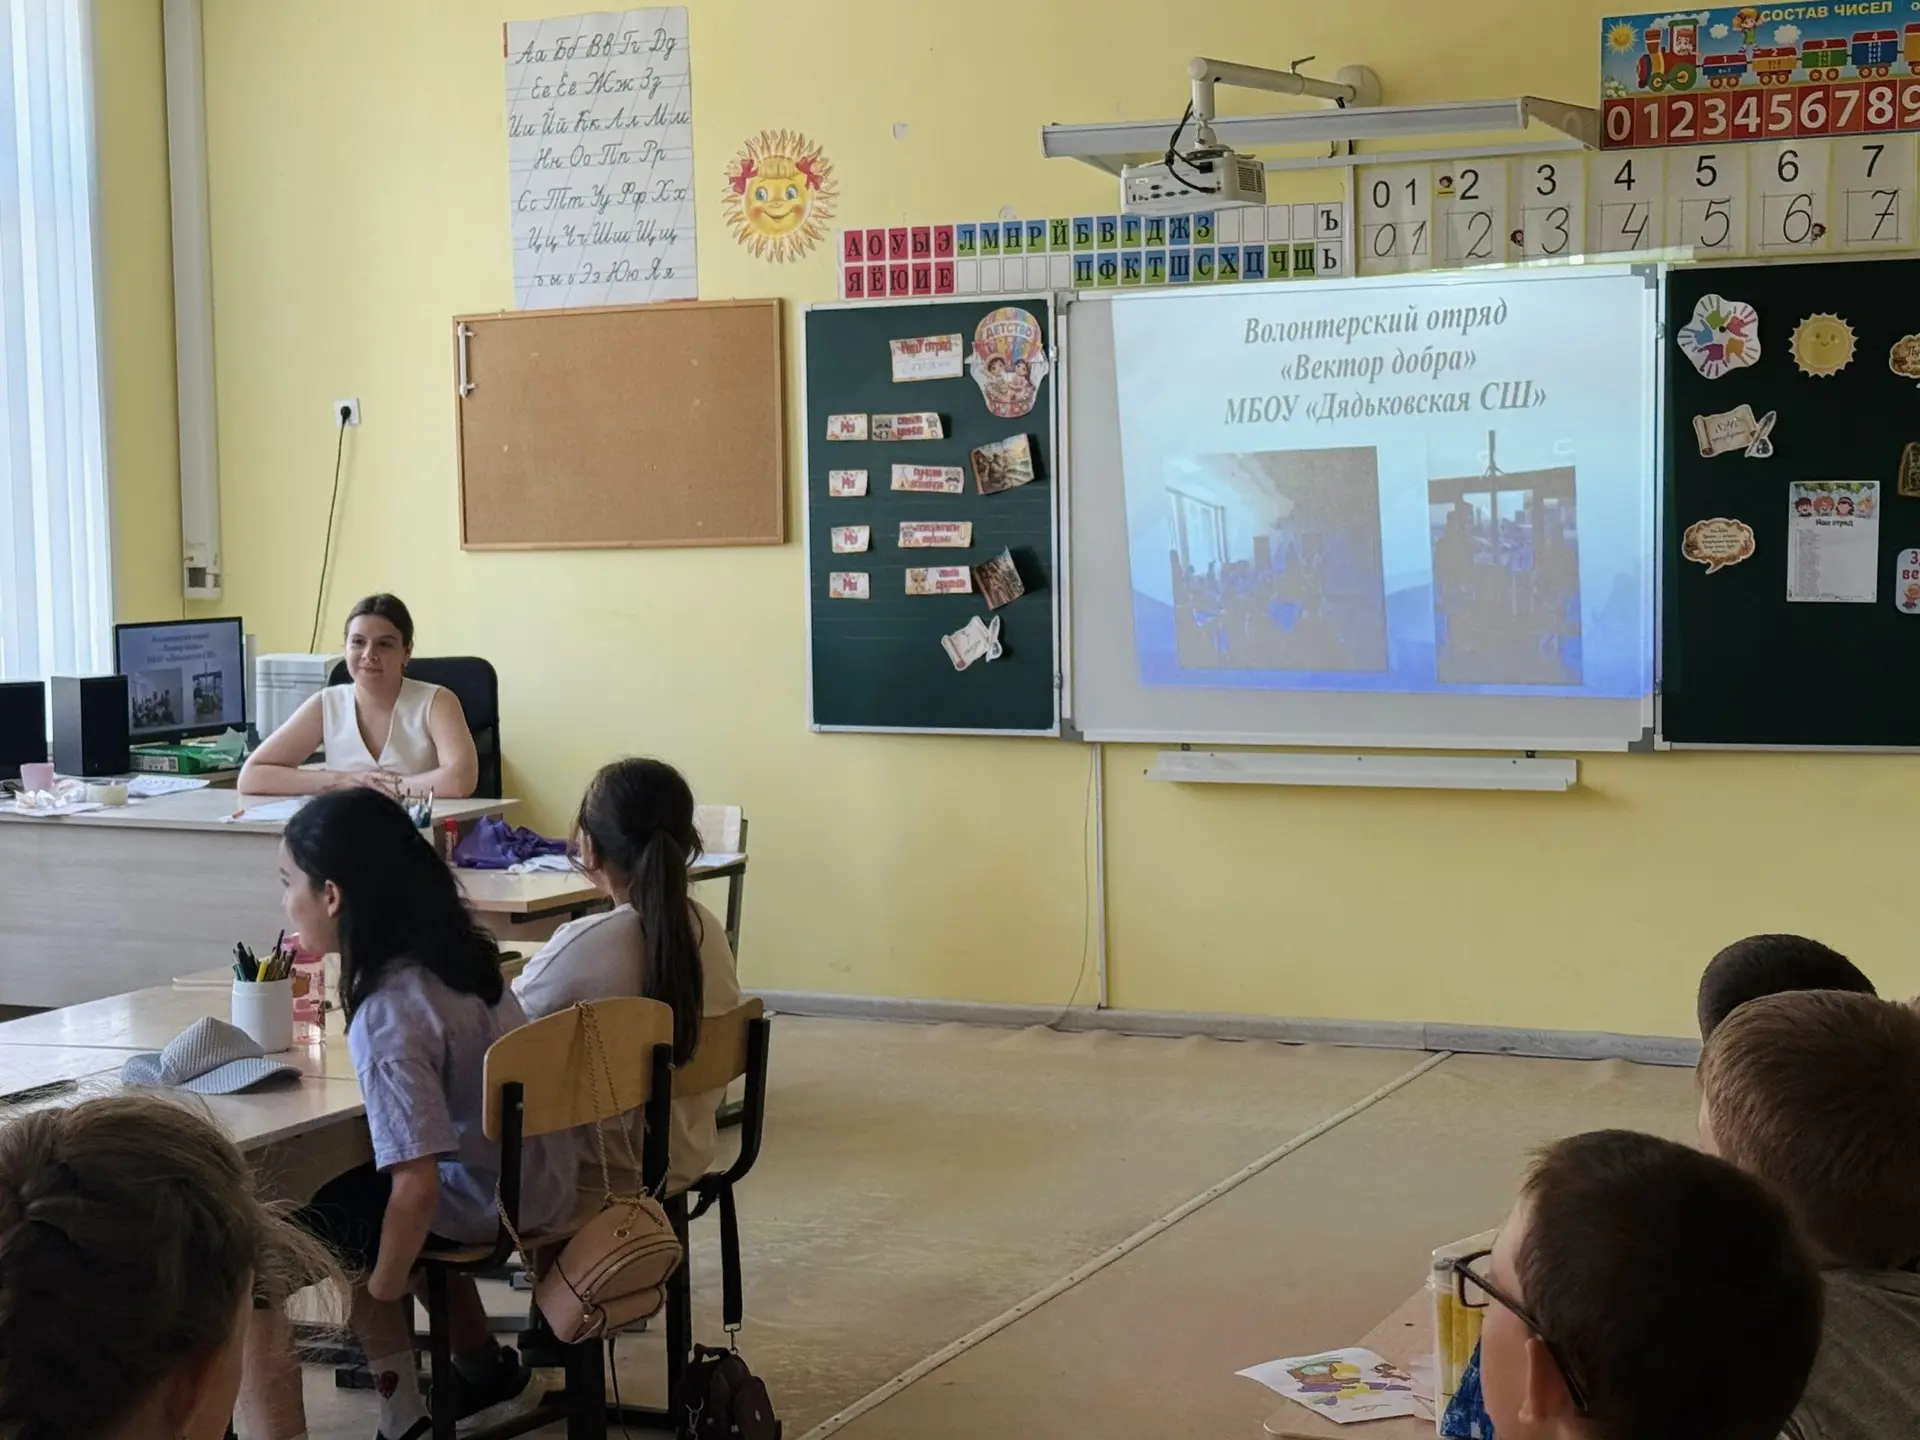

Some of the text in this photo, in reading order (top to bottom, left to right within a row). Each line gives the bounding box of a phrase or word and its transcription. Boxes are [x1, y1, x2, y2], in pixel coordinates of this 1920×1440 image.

[1761, 6, 1829, 23] СОСТАВ
[1834, 1, 1893, 17] ЧИСЕЛ
[515, 28, 677, 64] Аа Бб Вв Гг Дд
[531, 76, 550, 100] Ее
[585, 71, 634, 95] Жж
[640, 67, 662, 100] Зз
[509, 103, 690, 138] Ии Йй Кк Лл Мм
[533, 140, 666, 171] Нн Оо Пп Рр
[1373, 144, 1885, 208] 0 1 2 3 4 5 6 7
[517, 179, 687, 215] Сс Тт Уу Фф Хх
[528, 219, 678, 254] Цц Чч Шш Щщ
[846, 210, 1339, 257] А О У Ы Э Л М Н Р Й Б В Г Д Ж З Ъ
[579, 263, 601, 284] Ээ
[606, 260, 639, 283] Юю
[644, 257, 675, 281] Яя
[848, 249, 1337, 292] Я Ё Ю И Е П Ф К Т Ш С Х Ц Ч Щ Ь
[986, 323, 1034, 340] ДЕТСТВО
[1244, 297, 1509, 345] Волонтерский отряд
[1281, 345, 1477, 383] «Вектор добра»
[1225, 380, 1547, 425] МБОУ «Дядьковская СШ»
[1911, 550, 1920, 565] З
